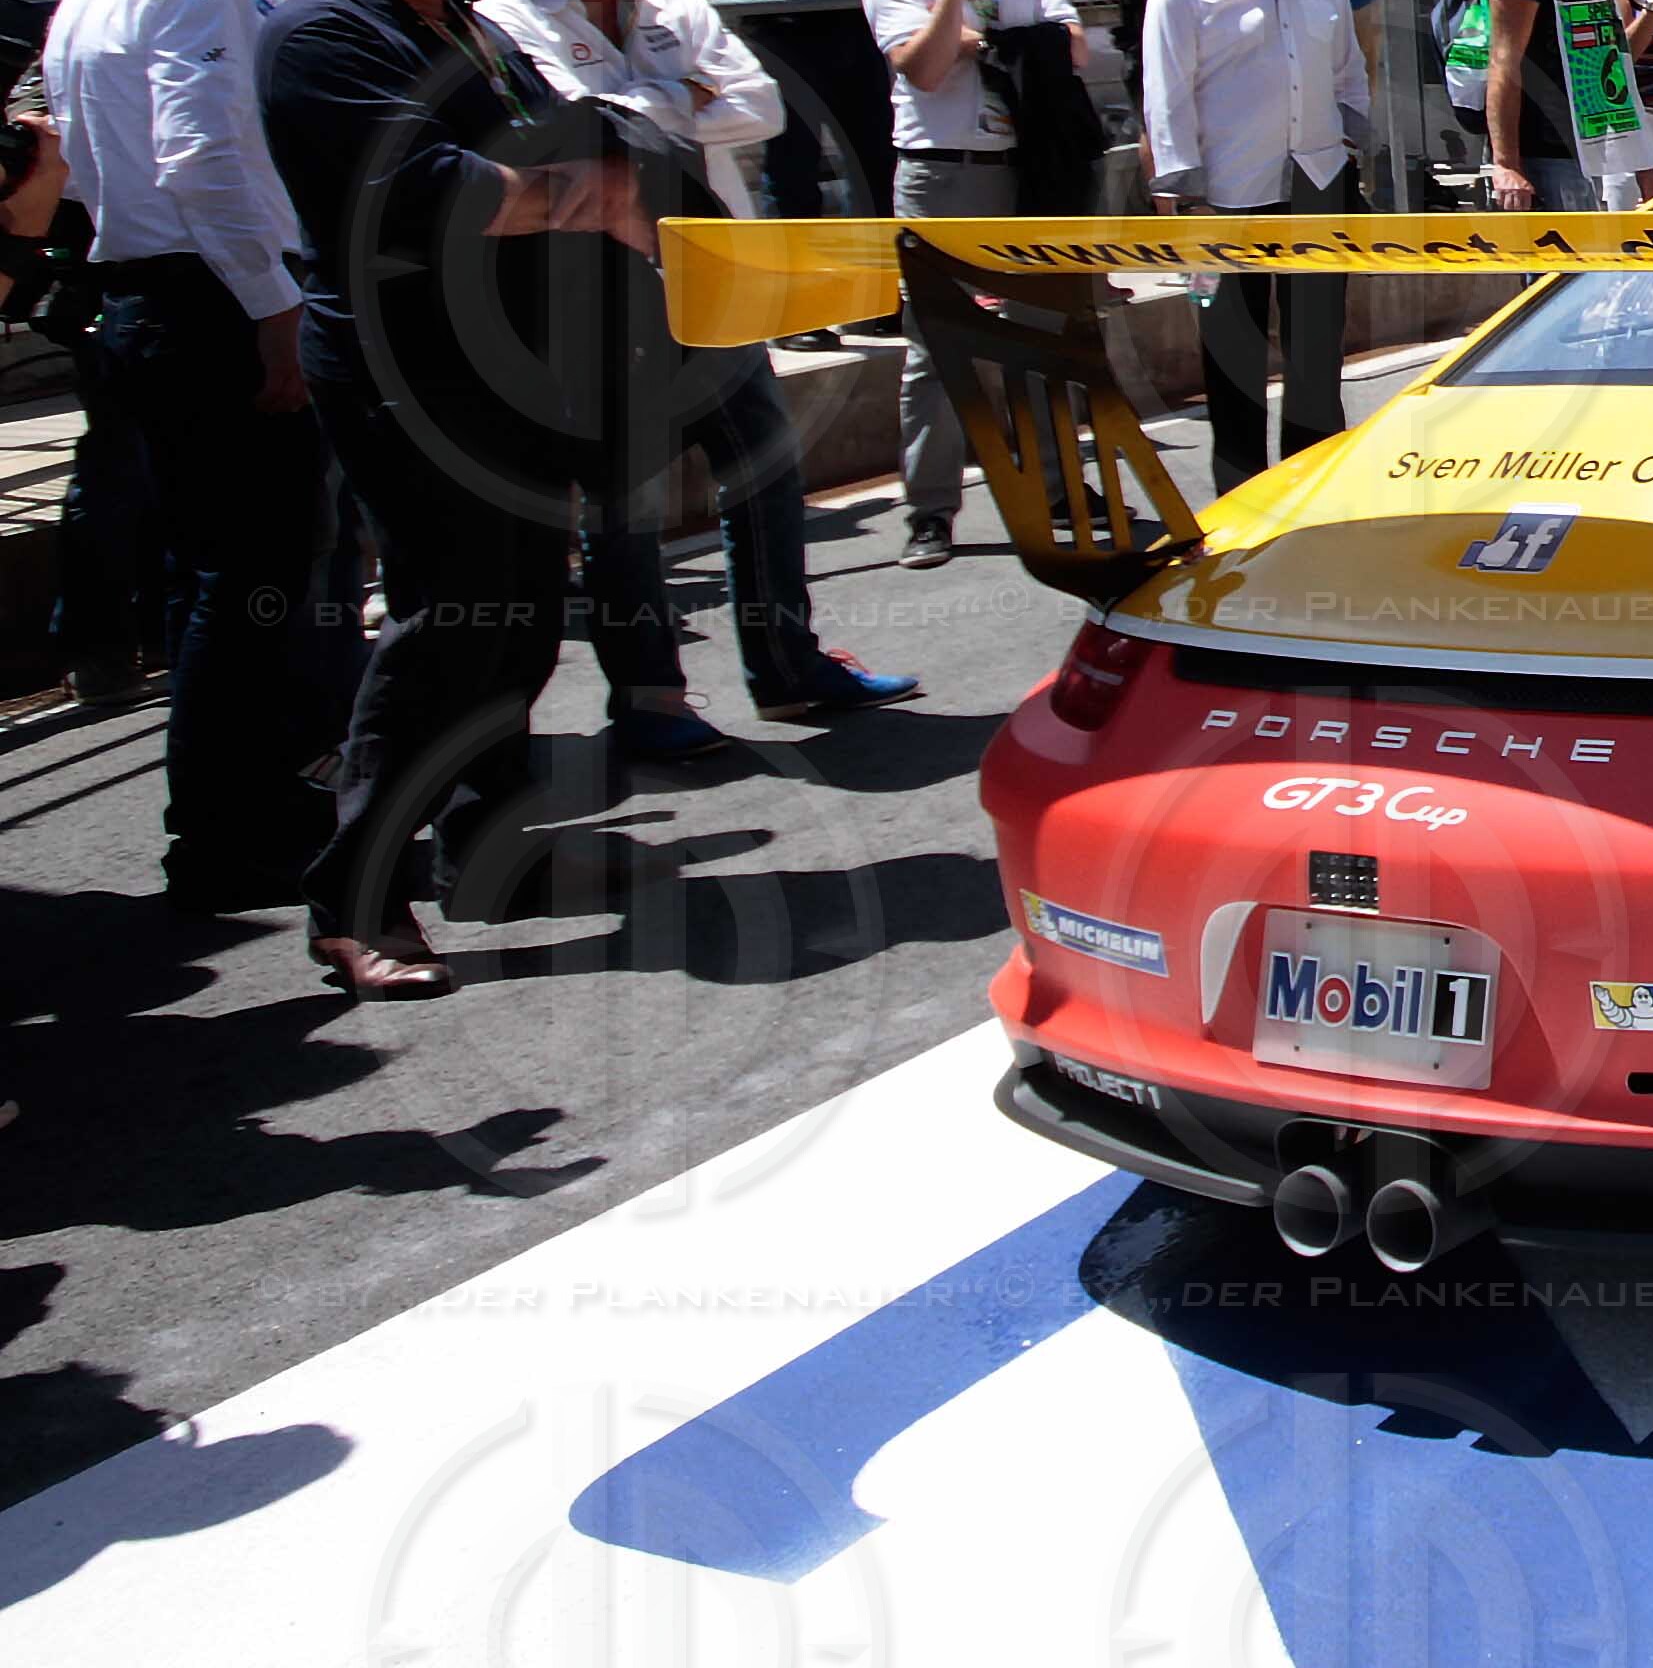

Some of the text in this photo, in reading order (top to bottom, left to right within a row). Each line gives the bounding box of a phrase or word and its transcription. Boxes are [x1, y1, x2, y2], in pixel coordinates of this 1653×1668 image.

[1388, 451, 1481, 480] Sven
[1489, 450, 1623, 482] Müller
[1202, 709, 1616, 762] PORSCHE
[1385, 786, 1469, 831] Cup
[1057, 917, 1160, 961] MICHELIN
[1265, 951, 1426, 1038] Mobil
[1055, 1054, 1162, 1110] PROJECT 1
